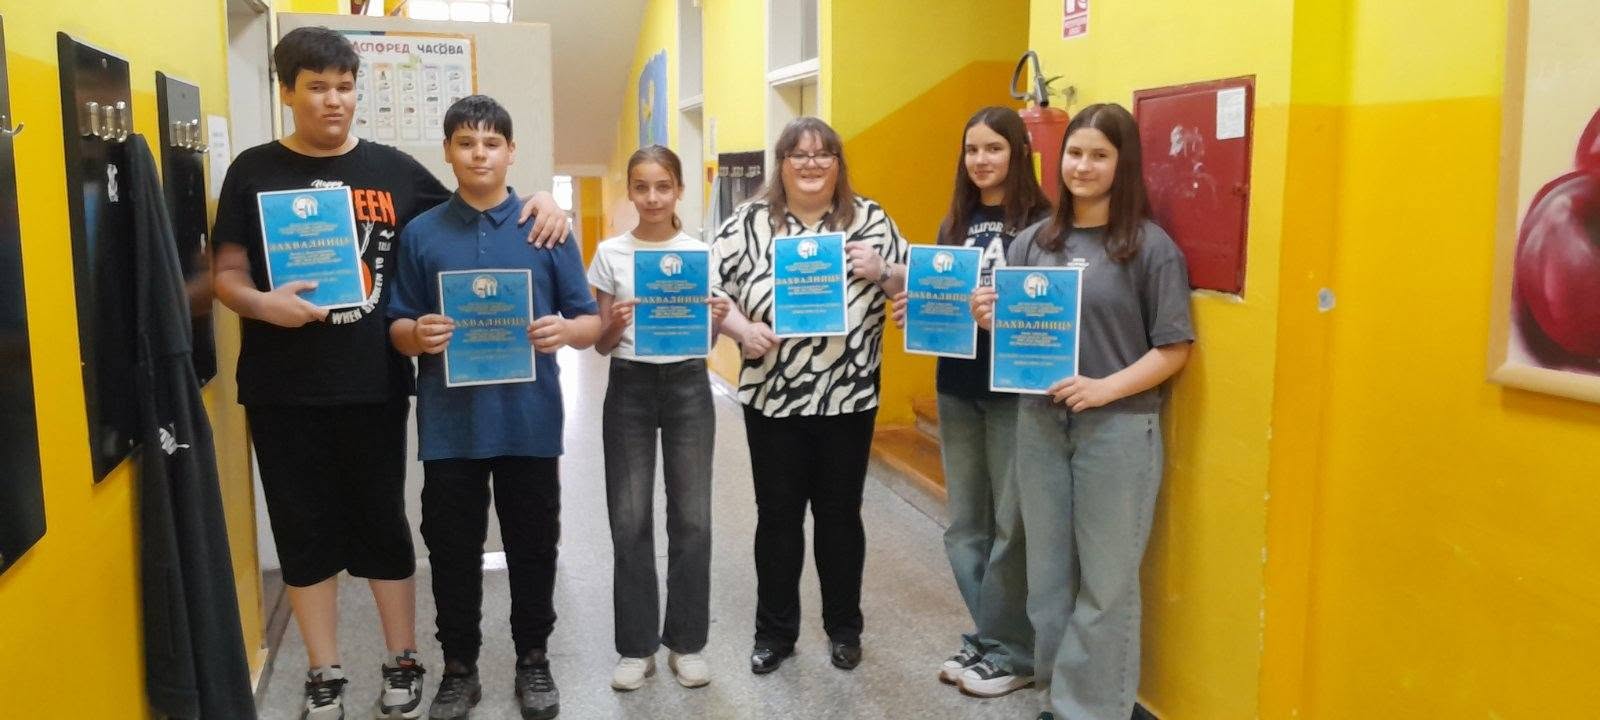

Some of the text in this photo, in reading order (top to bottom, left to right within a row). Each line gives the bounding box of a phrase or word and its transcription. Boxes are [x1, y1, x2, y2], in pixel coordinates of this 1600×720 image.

[352, 41, 464, 54] АСПОРЕД ЧАСОВА
[641, 296, 705, 305] АХВАЛНИЦУ
[332, 308, 363, 325] WHEN
[453, 317, 527, 329] АХВАЛНИЦУ
[996, 320, 1072, 330] ЗАХВАЛНИЦУ
